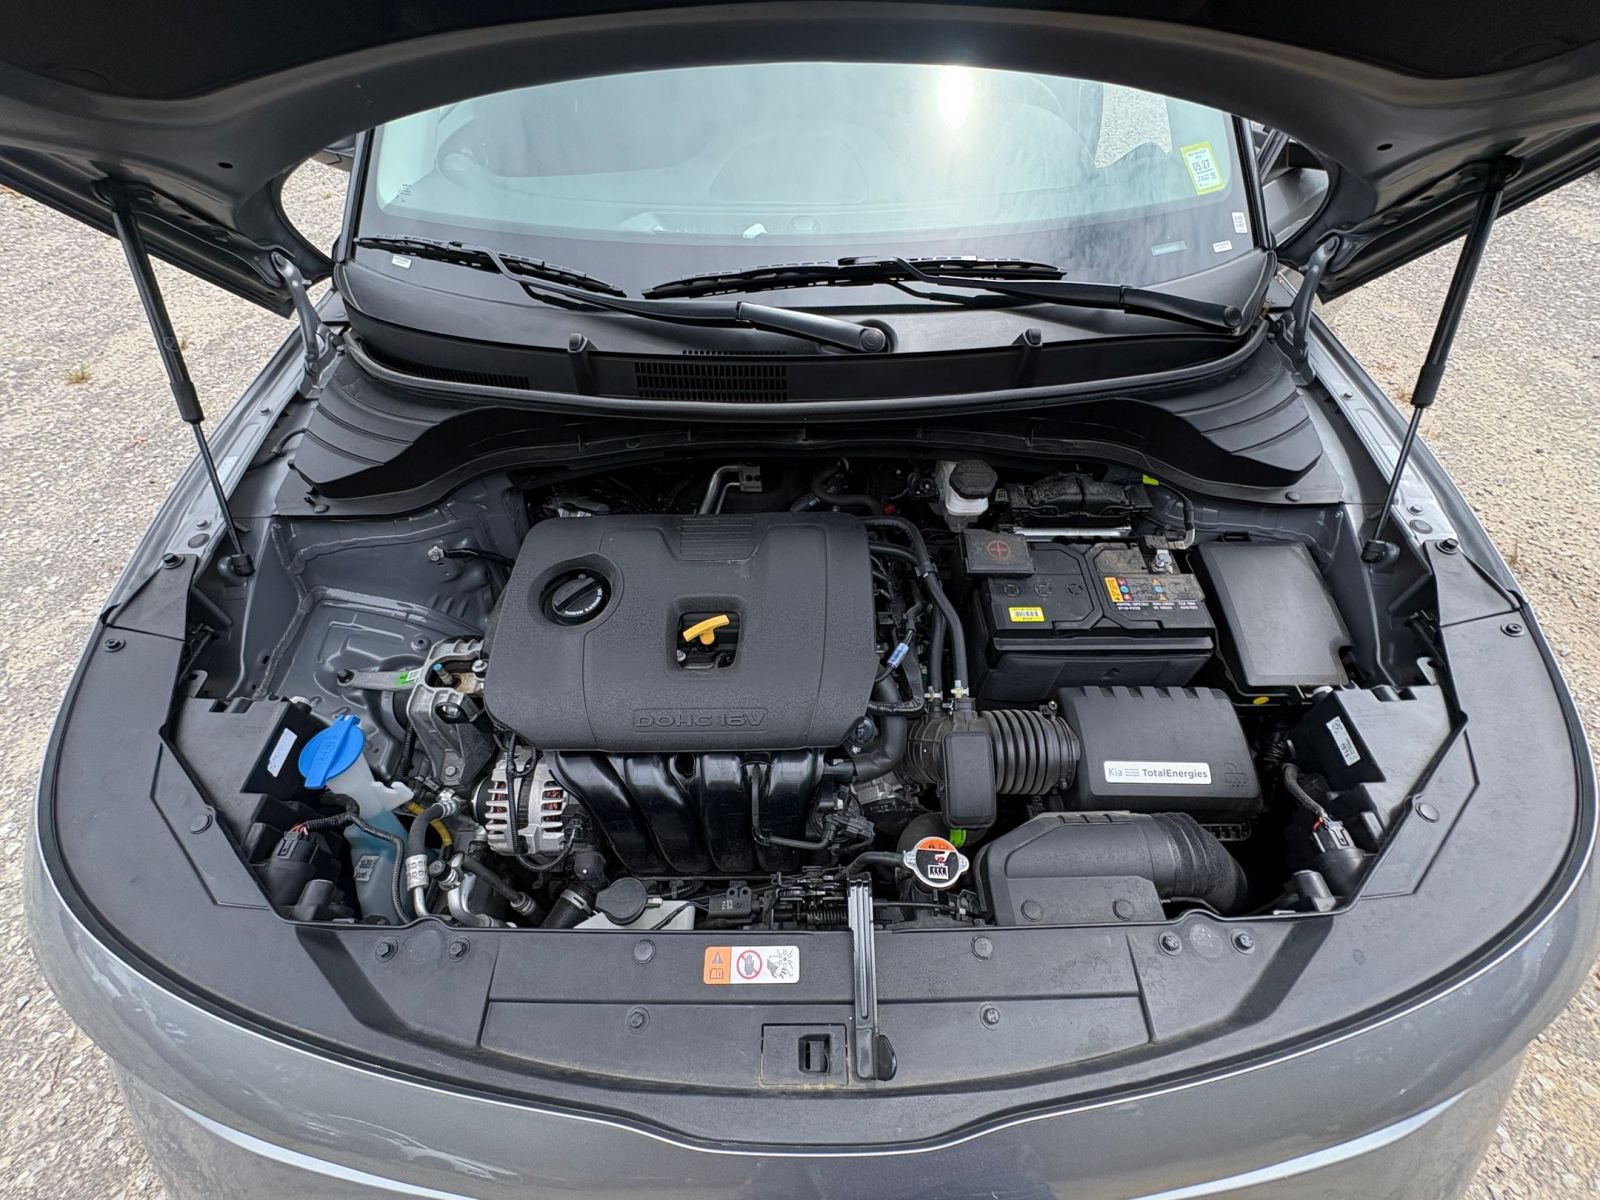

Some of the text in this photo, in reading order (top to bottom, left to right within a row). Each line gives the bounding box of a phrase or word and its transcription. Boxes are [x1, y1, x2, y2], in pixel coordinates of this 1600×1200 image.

[635, 713, 766, 728] DOHC 16V
[1108, 767, 1208, 779] Kia TotalEnergies
